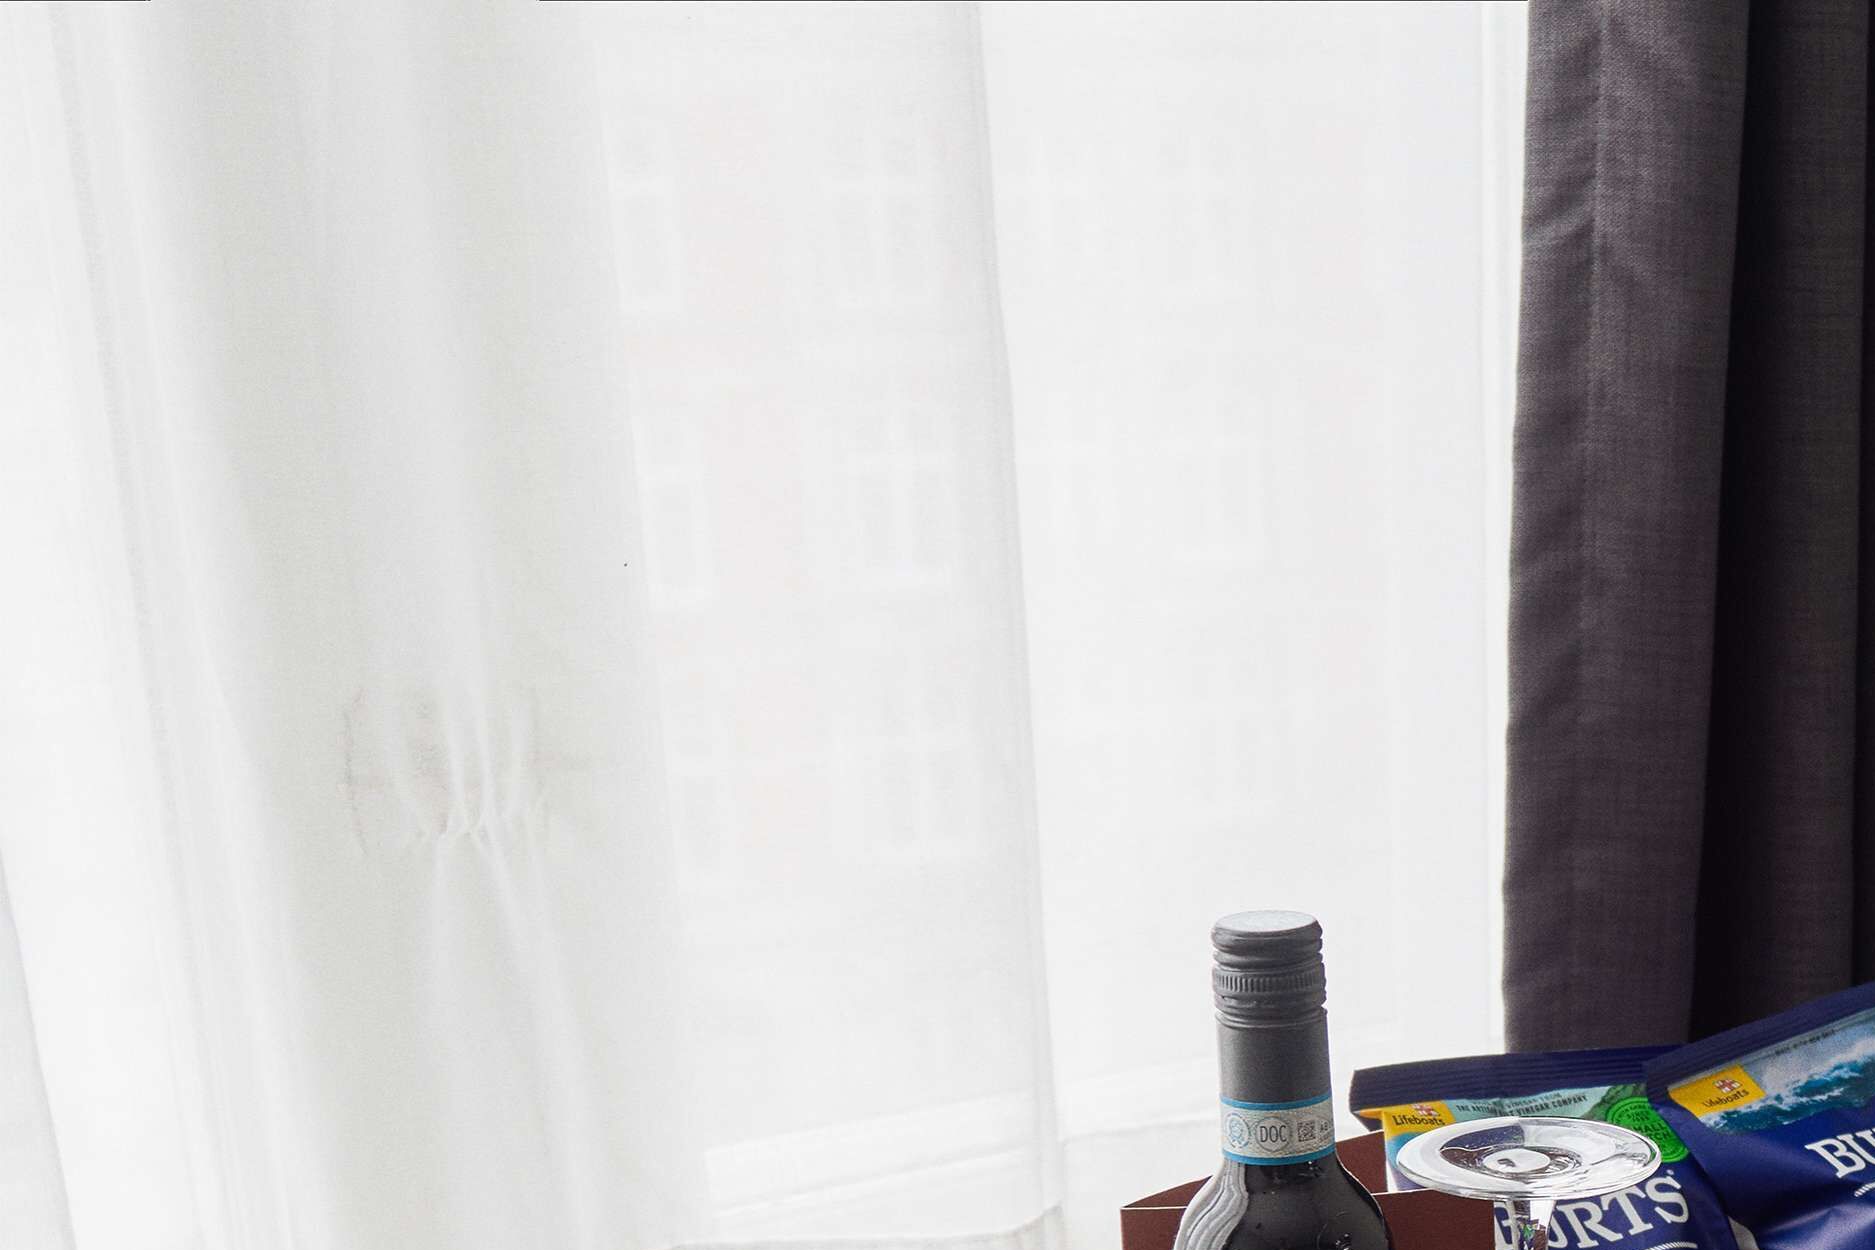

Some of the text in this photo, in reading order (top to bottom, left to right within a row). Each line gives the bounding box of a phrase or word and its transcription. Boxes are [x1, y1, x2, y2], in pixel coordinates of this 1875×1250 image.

[1551, 1093, 1588, 1109] COMPANY
[1393, 1113, 1445, 1126] Lifeboats
[1260, 1124, 1288, 1143] DOC
